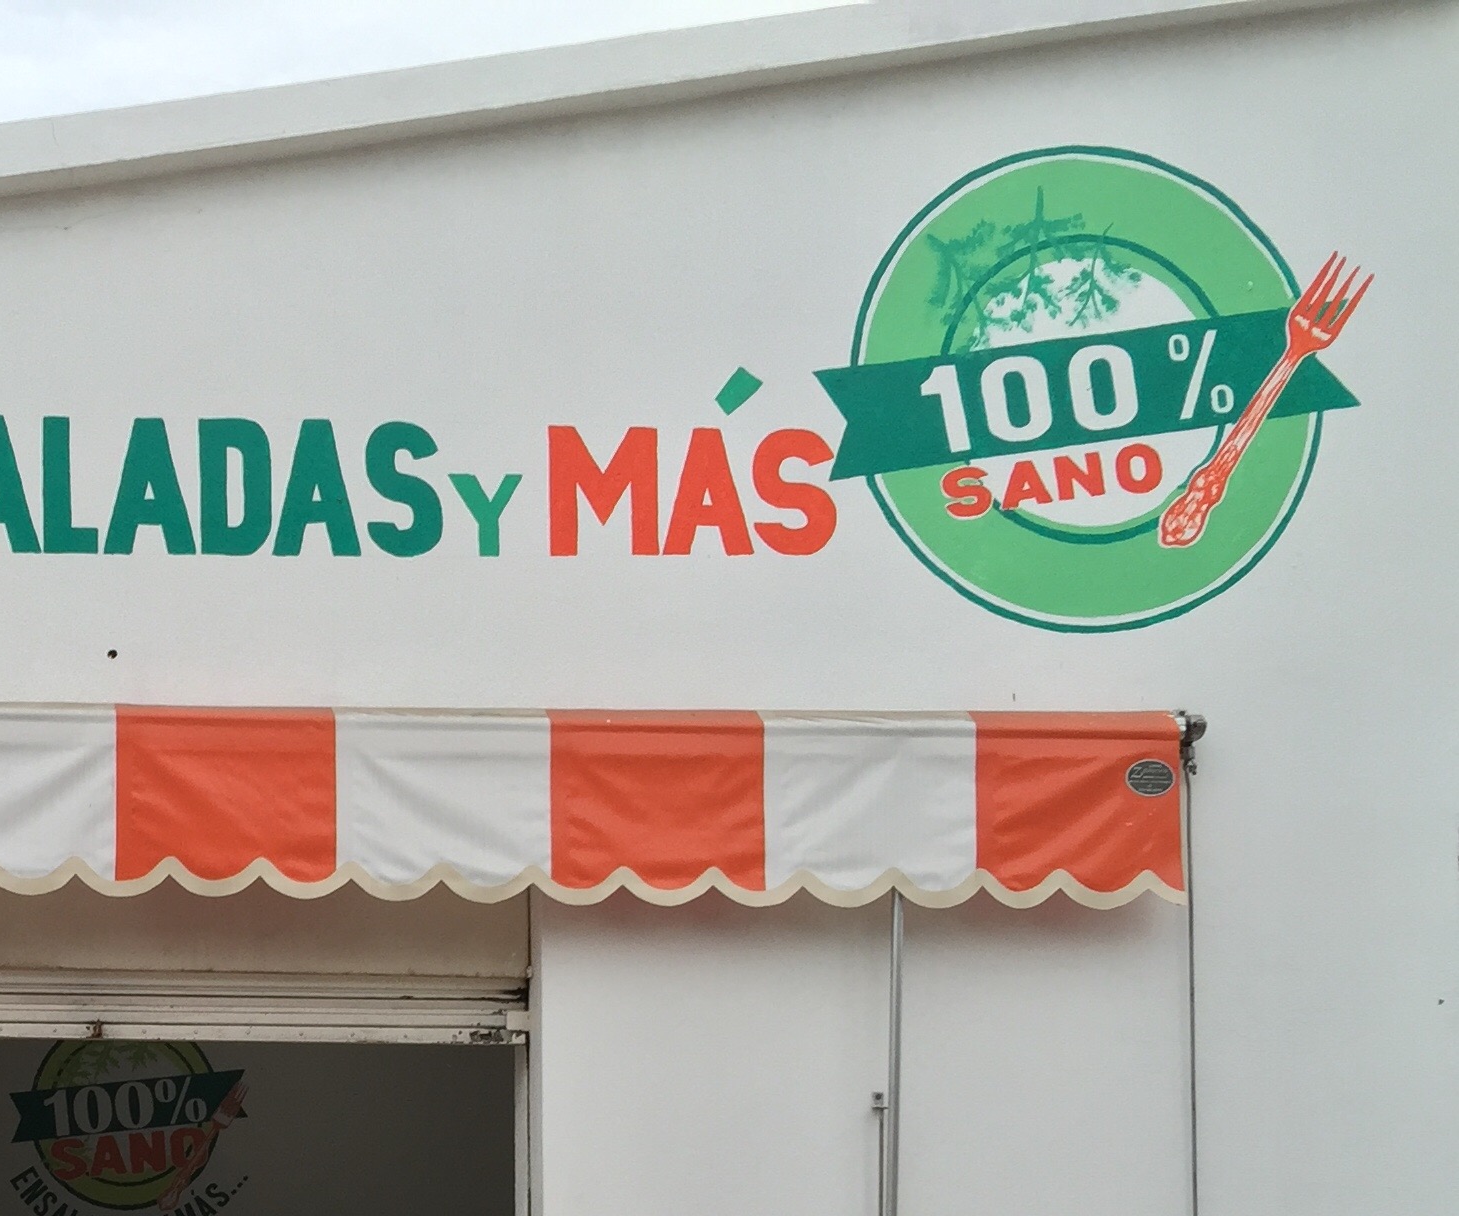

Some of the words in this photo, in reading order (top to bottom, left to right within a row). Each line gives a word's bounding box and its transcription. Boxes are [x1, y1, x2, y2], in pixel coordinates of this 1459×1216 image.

[449, 473, 522, 557] Y
[547, 367, 838, 557] MÁS
[941, 443, 1163, 518] SANO
[50, 1127, 208, 1181] SANO
